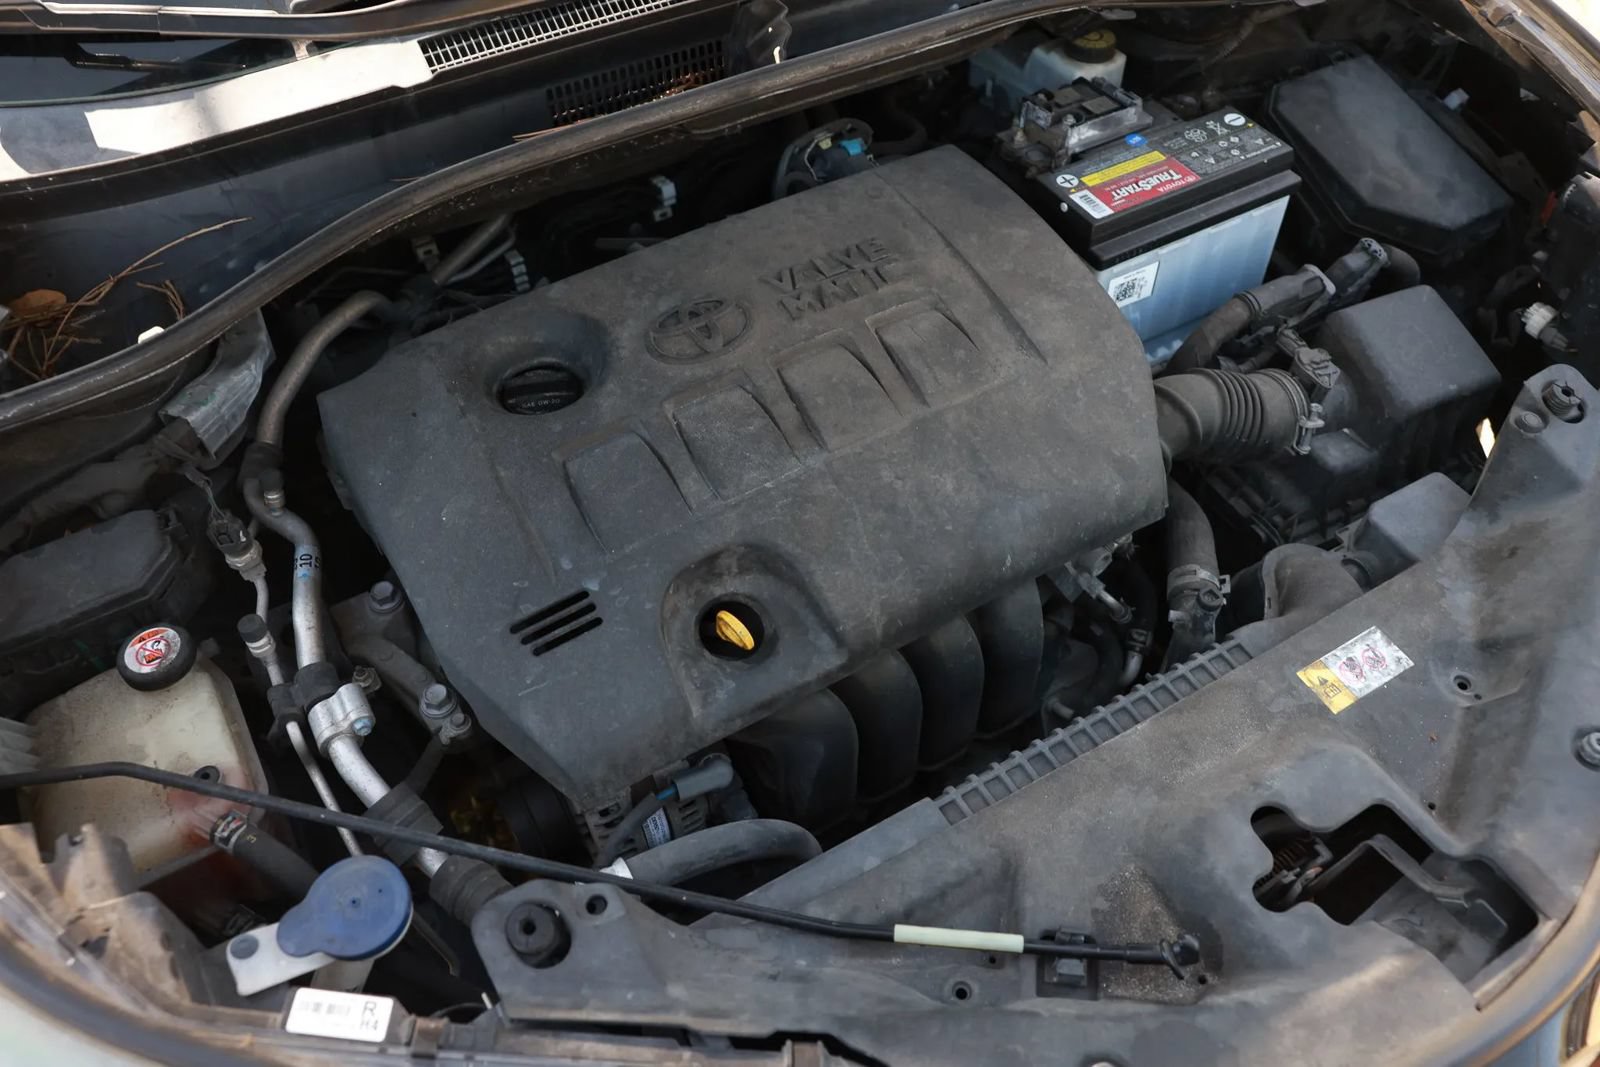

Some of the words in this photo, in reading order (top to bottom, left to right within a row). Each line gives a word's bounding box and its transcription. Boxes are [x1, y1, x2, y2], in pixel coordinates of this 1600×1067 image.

[1156, 179, 1187, 193] TOYOTA
[758, 238, 889, 293] VALVE
[362, 1000, 377, 1017] R
